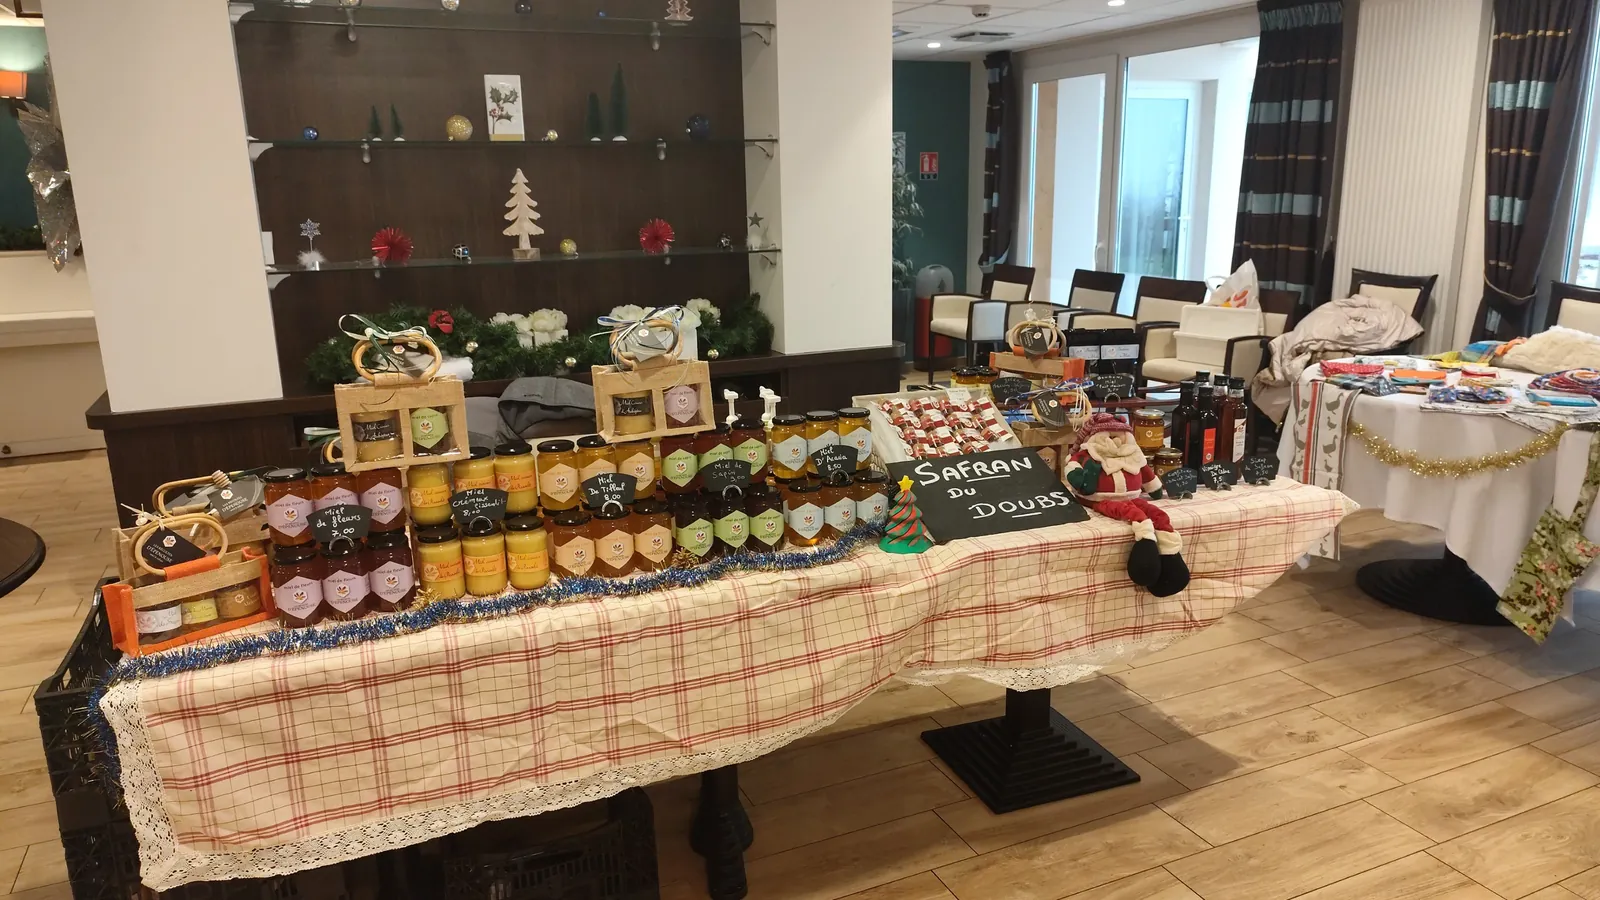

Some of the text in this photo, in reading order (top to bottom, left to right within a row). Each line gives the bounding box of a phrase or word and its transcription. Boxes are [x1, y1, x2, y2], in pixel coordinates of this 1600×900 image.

[820, 446, 834, 456] Miel
[914, 456, 1033, 487] SAFRAN
[598, 474, 613, 485] Miel
[466, 489, 485, 497] Miel
[968, 491, 1070, 520] DOUBS
[324, 507, 345, 516] Miel
[316, 514, 361, 528] de fleurs
